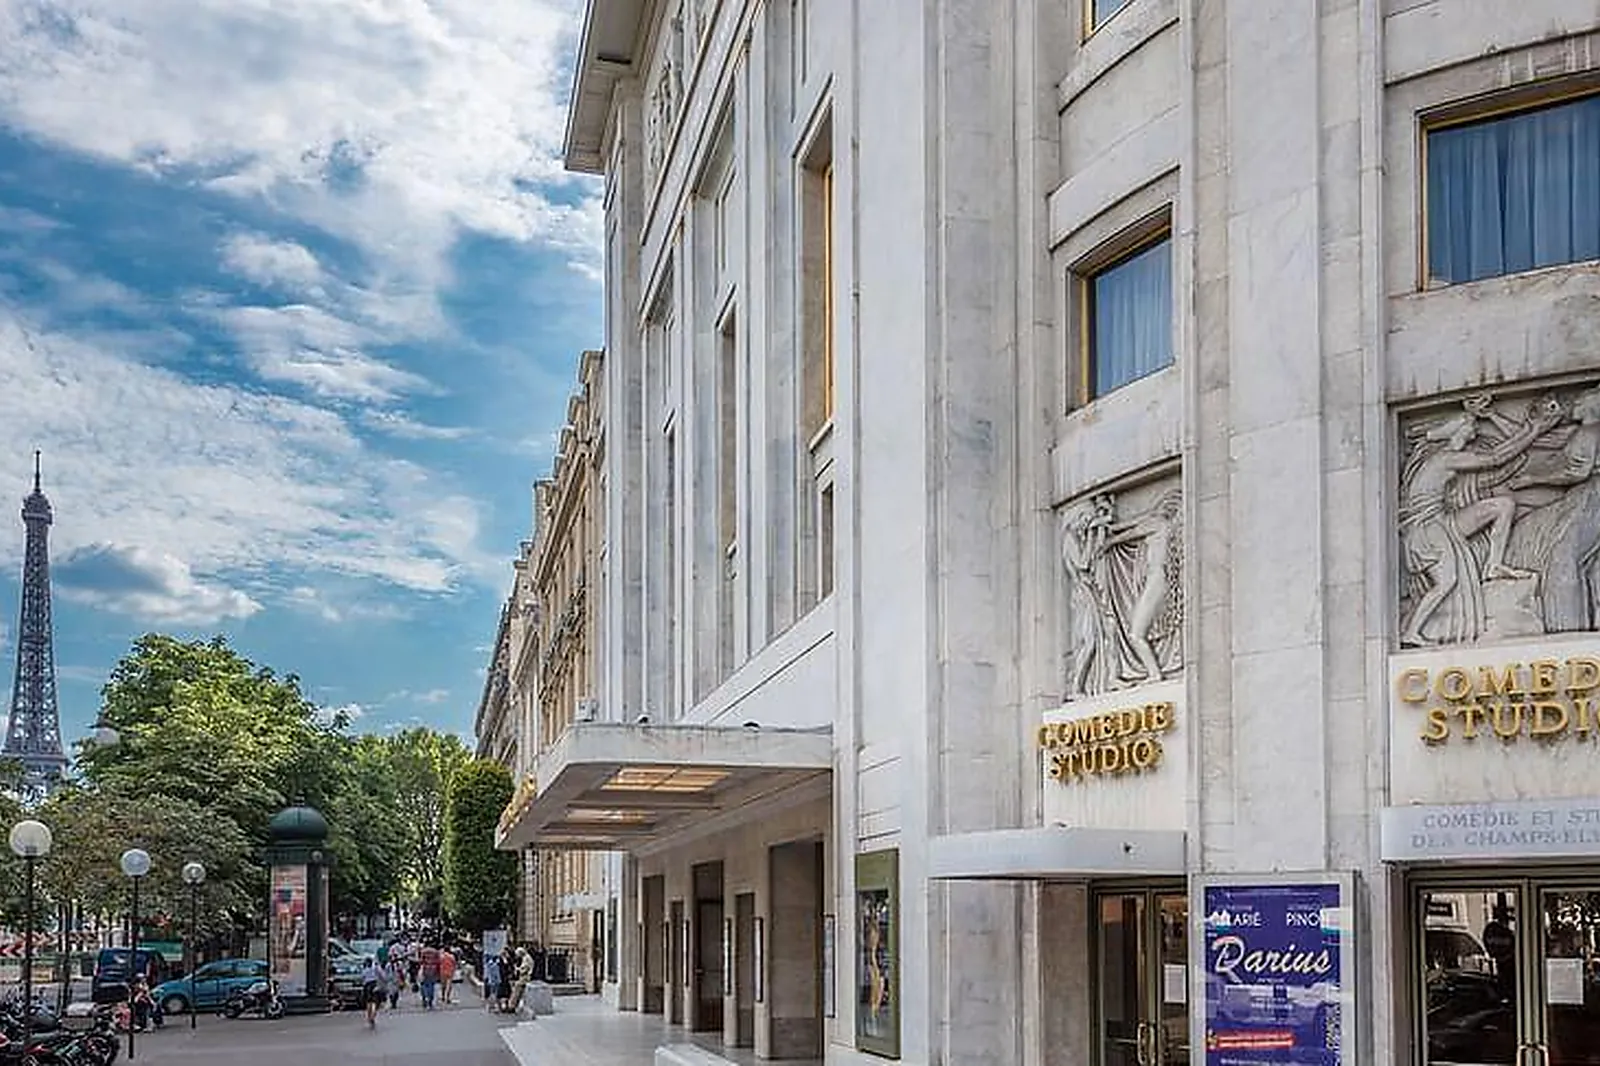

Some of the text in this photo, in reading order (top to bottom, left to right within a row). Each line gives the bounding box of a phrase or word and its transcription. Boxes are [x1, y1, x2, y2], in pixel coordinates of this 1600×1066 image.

[1039, 701, 1174, 748] COMEDIE
[1421, 698, 1600, 743] STUDI
[1050, 738, 1162, 781] STUDIO
[1424, 811, 1519, 828] COMEDIE
[1531, 810, 1554, 825] ET
[1212, 935, 1332, 983] Darius
